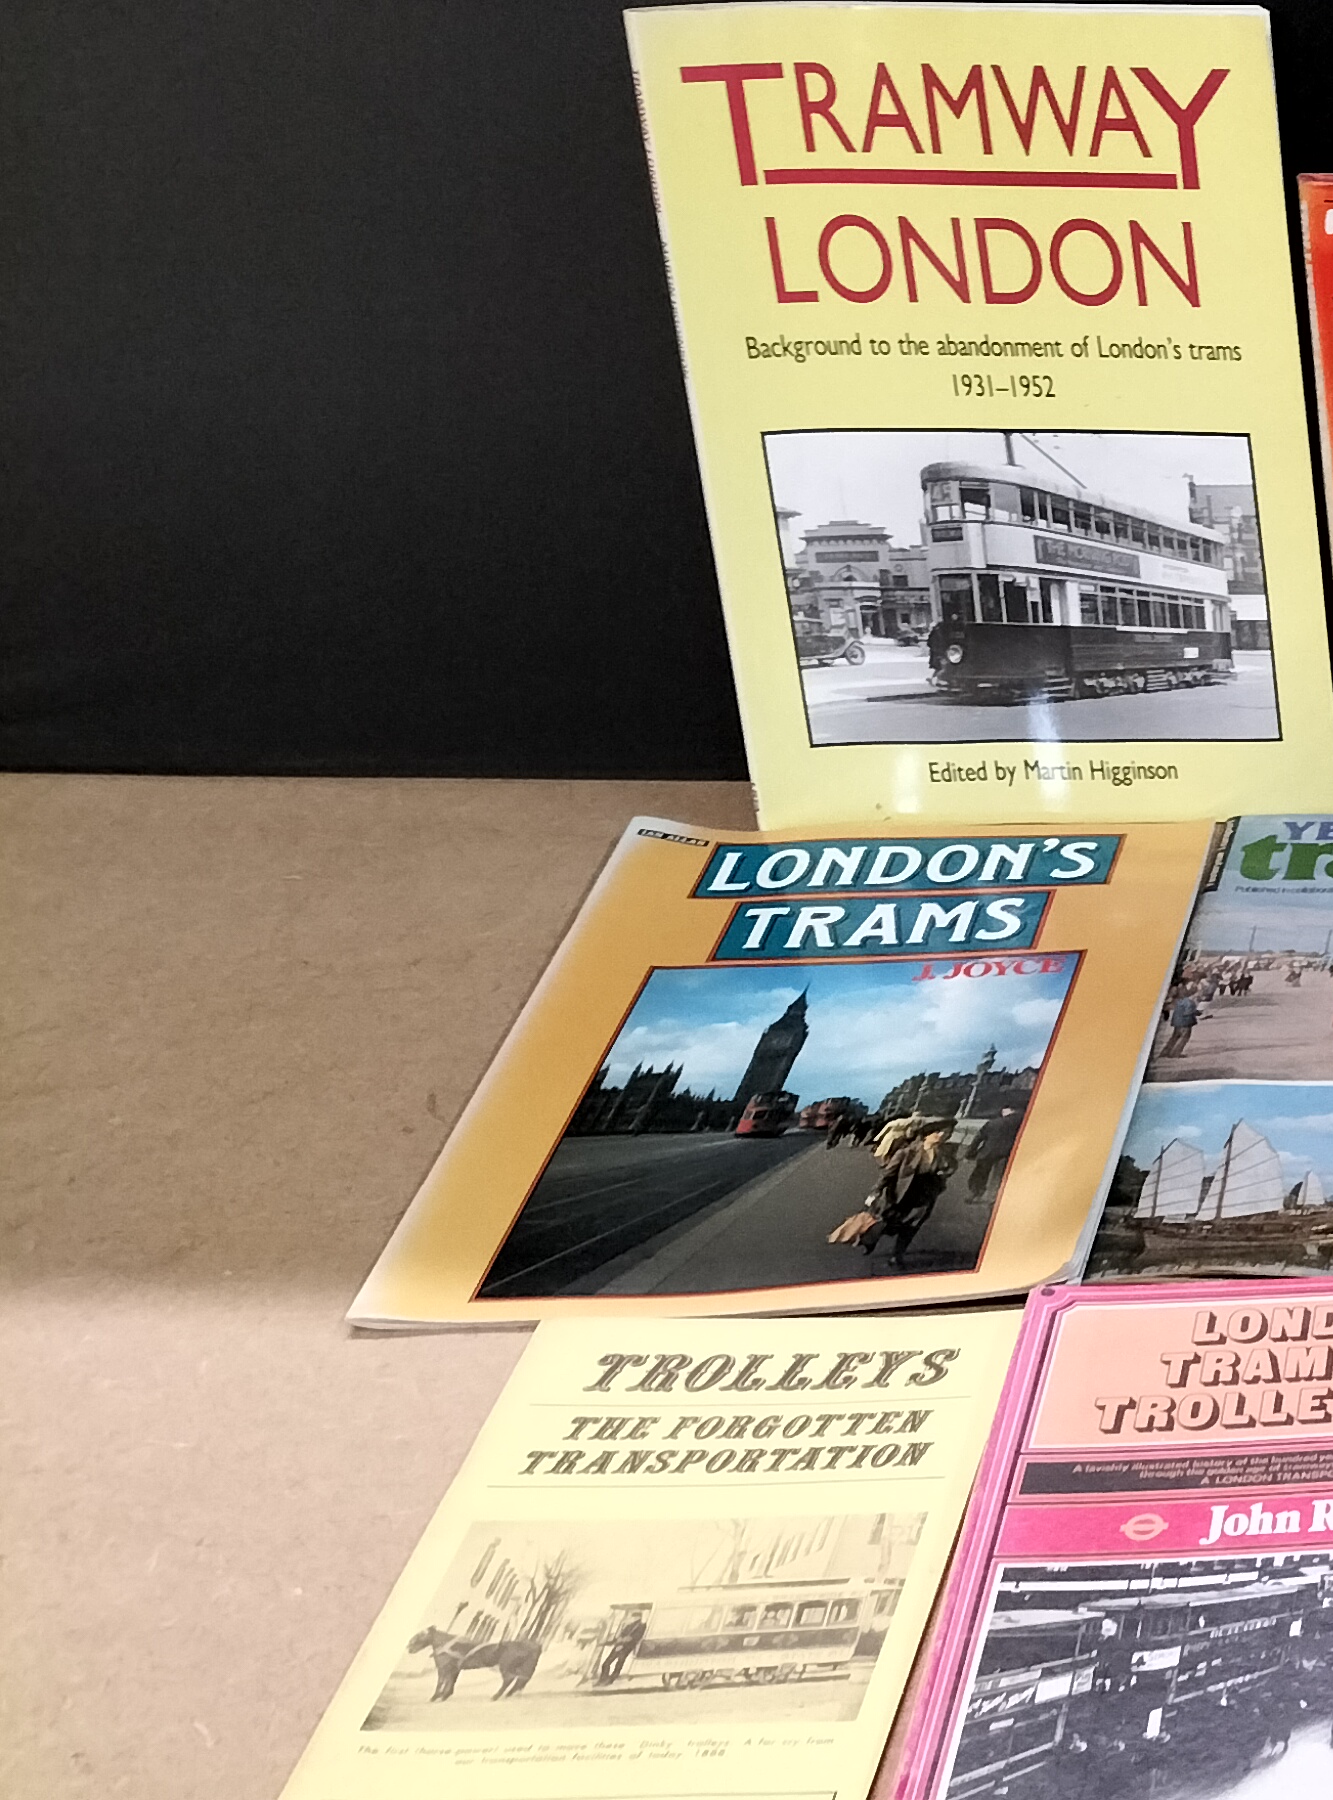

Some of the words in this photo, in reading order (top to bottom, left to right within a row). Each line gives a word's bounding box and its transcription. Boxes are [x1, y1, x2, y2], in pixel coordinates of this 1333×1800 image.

[680, 61, 1231, 190] TRAMWAY
[764, 213, 1201, 308] LONDON
[745, 333, 862, 363] Background
[869, 337, 891, 356] to
[899, 333, 929, 356] the
[937, 334, 1064, 358] abandonment
[1070, 336, 1090, 359] of
[1098, 336, 1182, 361] London's
[1188, 340, 1243, 362] trams
[928, 760, 988, 784] Edited
[994, 760, 1017, 786] by
[1022, 759, 1083, 782] Martin
[1089, 758, 1179, 786] Higginson
[707, 837, 1100, 894] LONDON'S
[741, 896, 1027, 950] TRAMS
[911, 962, 938, 982] J.
[942, 957, 1066, 981] JOYCE
[582, 1348, 962, 1393] TROLLEYS
[562, 1415, 662, 1441] THE
[663, 1410, 935, 1440] FORGOTTEN
[518, 1441, 935, 1475] TRANSPORTATION
[1215, 1473, 1272, 1485] LONDON
[1200, 1505, 1301, 1547] John
